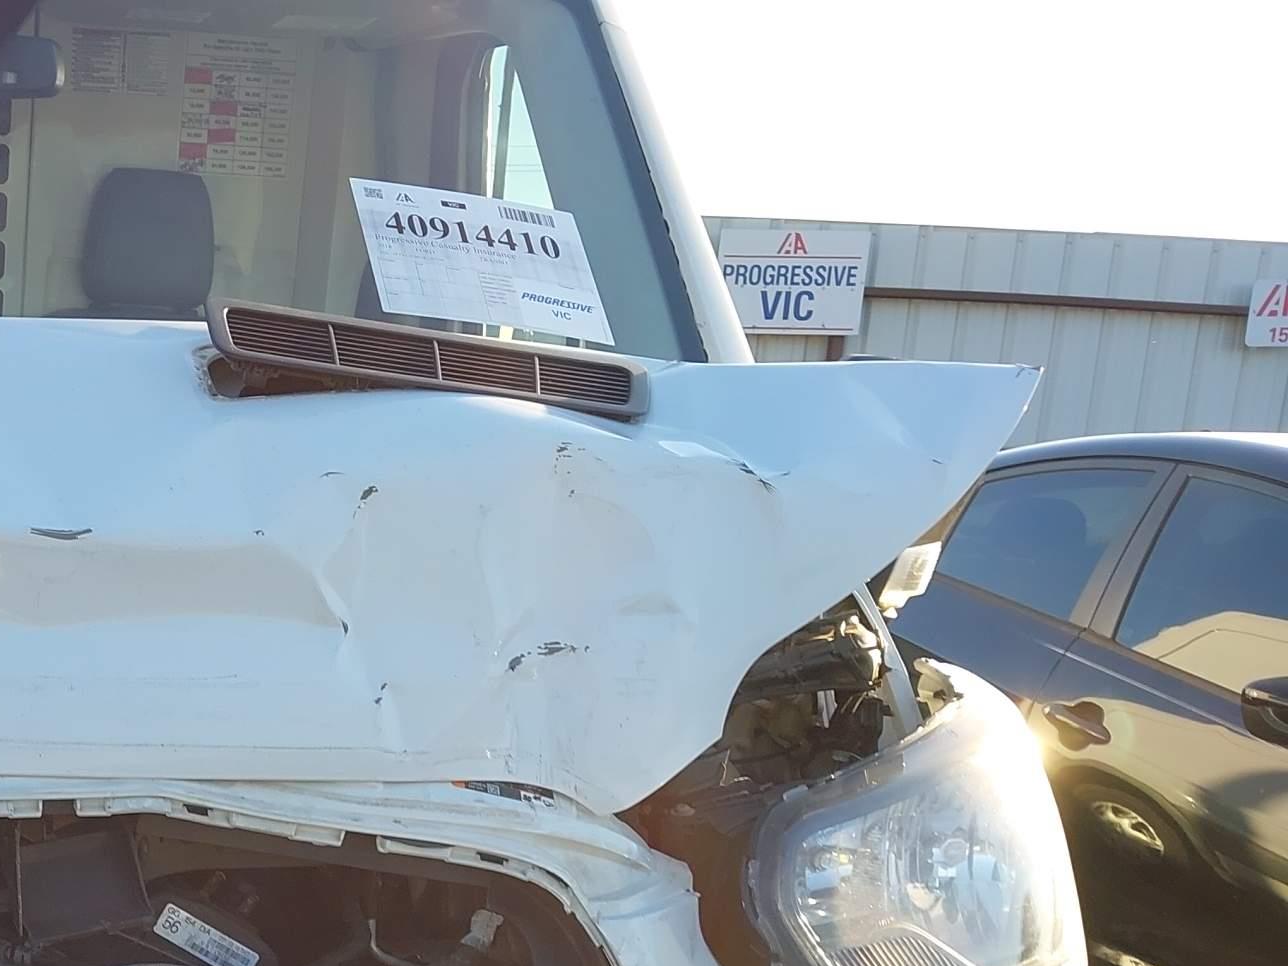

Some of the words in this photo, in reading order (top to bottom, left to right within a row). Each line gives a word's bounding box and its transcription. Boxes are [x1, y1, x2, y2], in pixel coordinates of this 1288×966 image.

[385, 211, 561, 259] 40914410
[723, 264, 858, 287] PROGRESSIVE
[521, 292, 593, 313] PROGRESSIVE
[760, 290, 814, 321] VIC
[552, 309, 572, 320] VIC
[162, 916, 182, 934] 56
